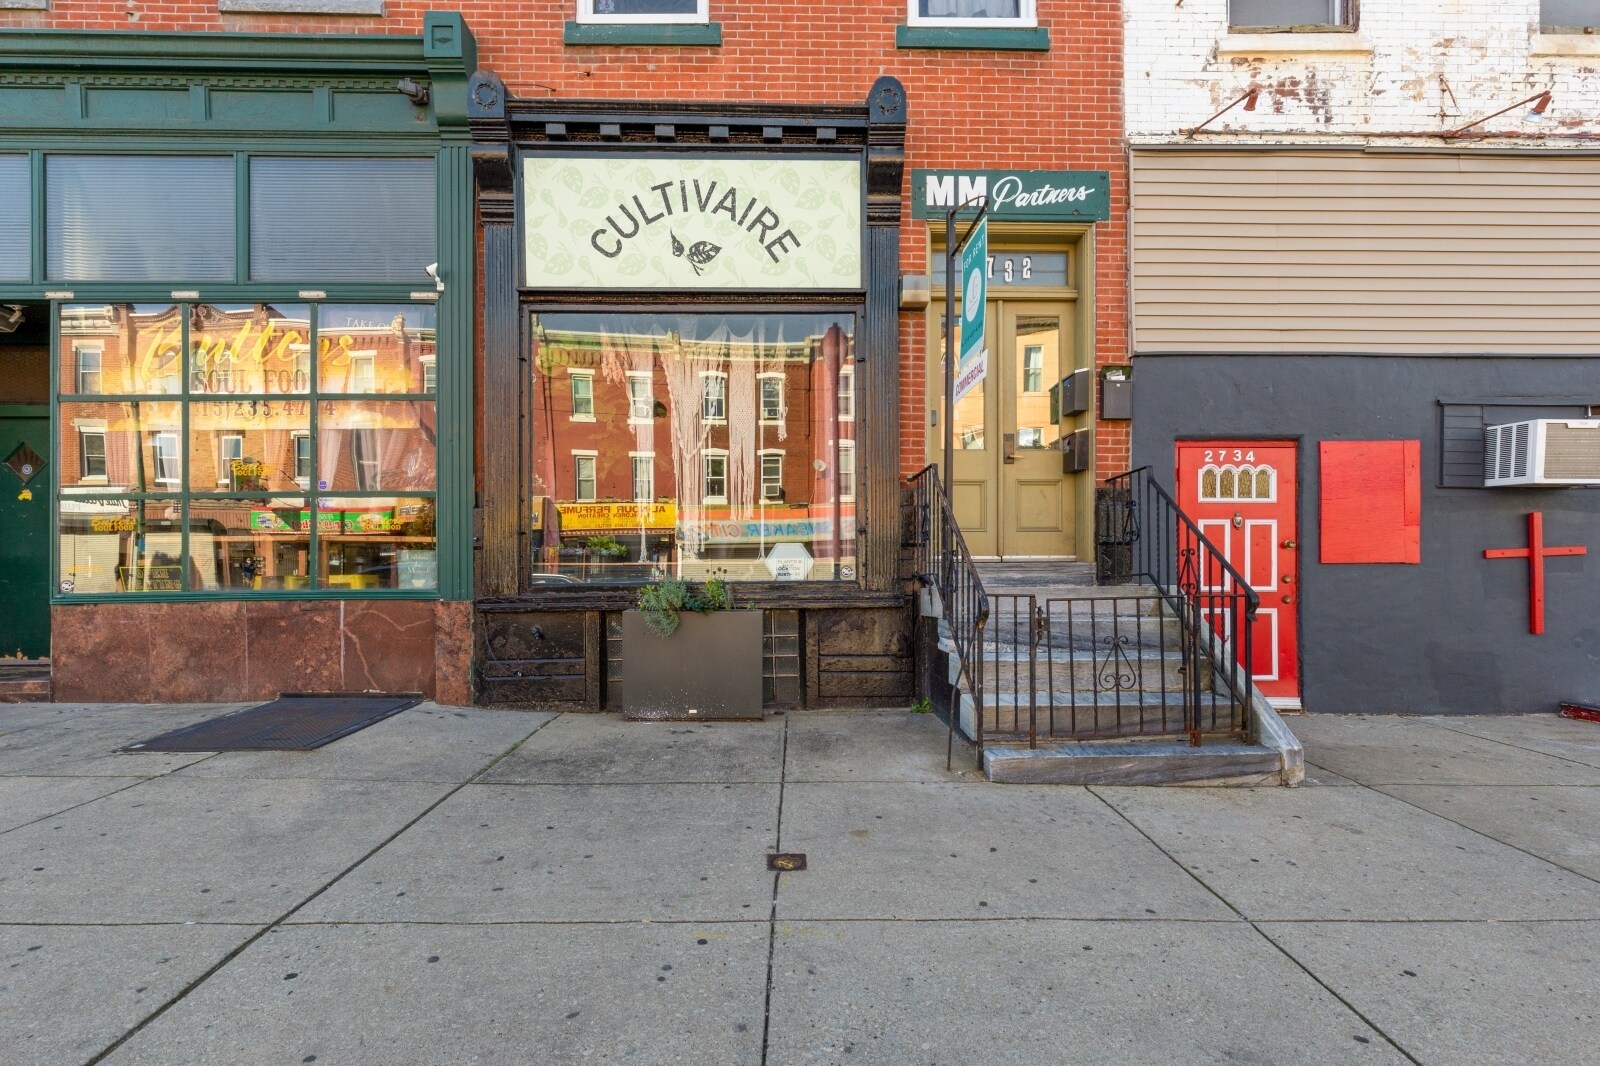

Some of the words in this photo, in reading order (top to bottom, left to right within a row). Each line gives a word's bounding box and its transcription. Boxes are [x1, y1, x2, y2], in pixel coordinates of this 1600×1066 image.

[926, 175, 987, 206] MM
[992, 176, 1095, 212] Partners
[590, 178, 801, 264] CULTIVAIRE
[973, 234, 985, 258] RENT
[345, 316, 374, 329] TAKE
[194, 369, 252, 394] SOUL
[264, 369, 310, 394] FOO
[955, 360, 984, 397] COMMERCIAL
[1204, 449, 1256, 463] 2734
